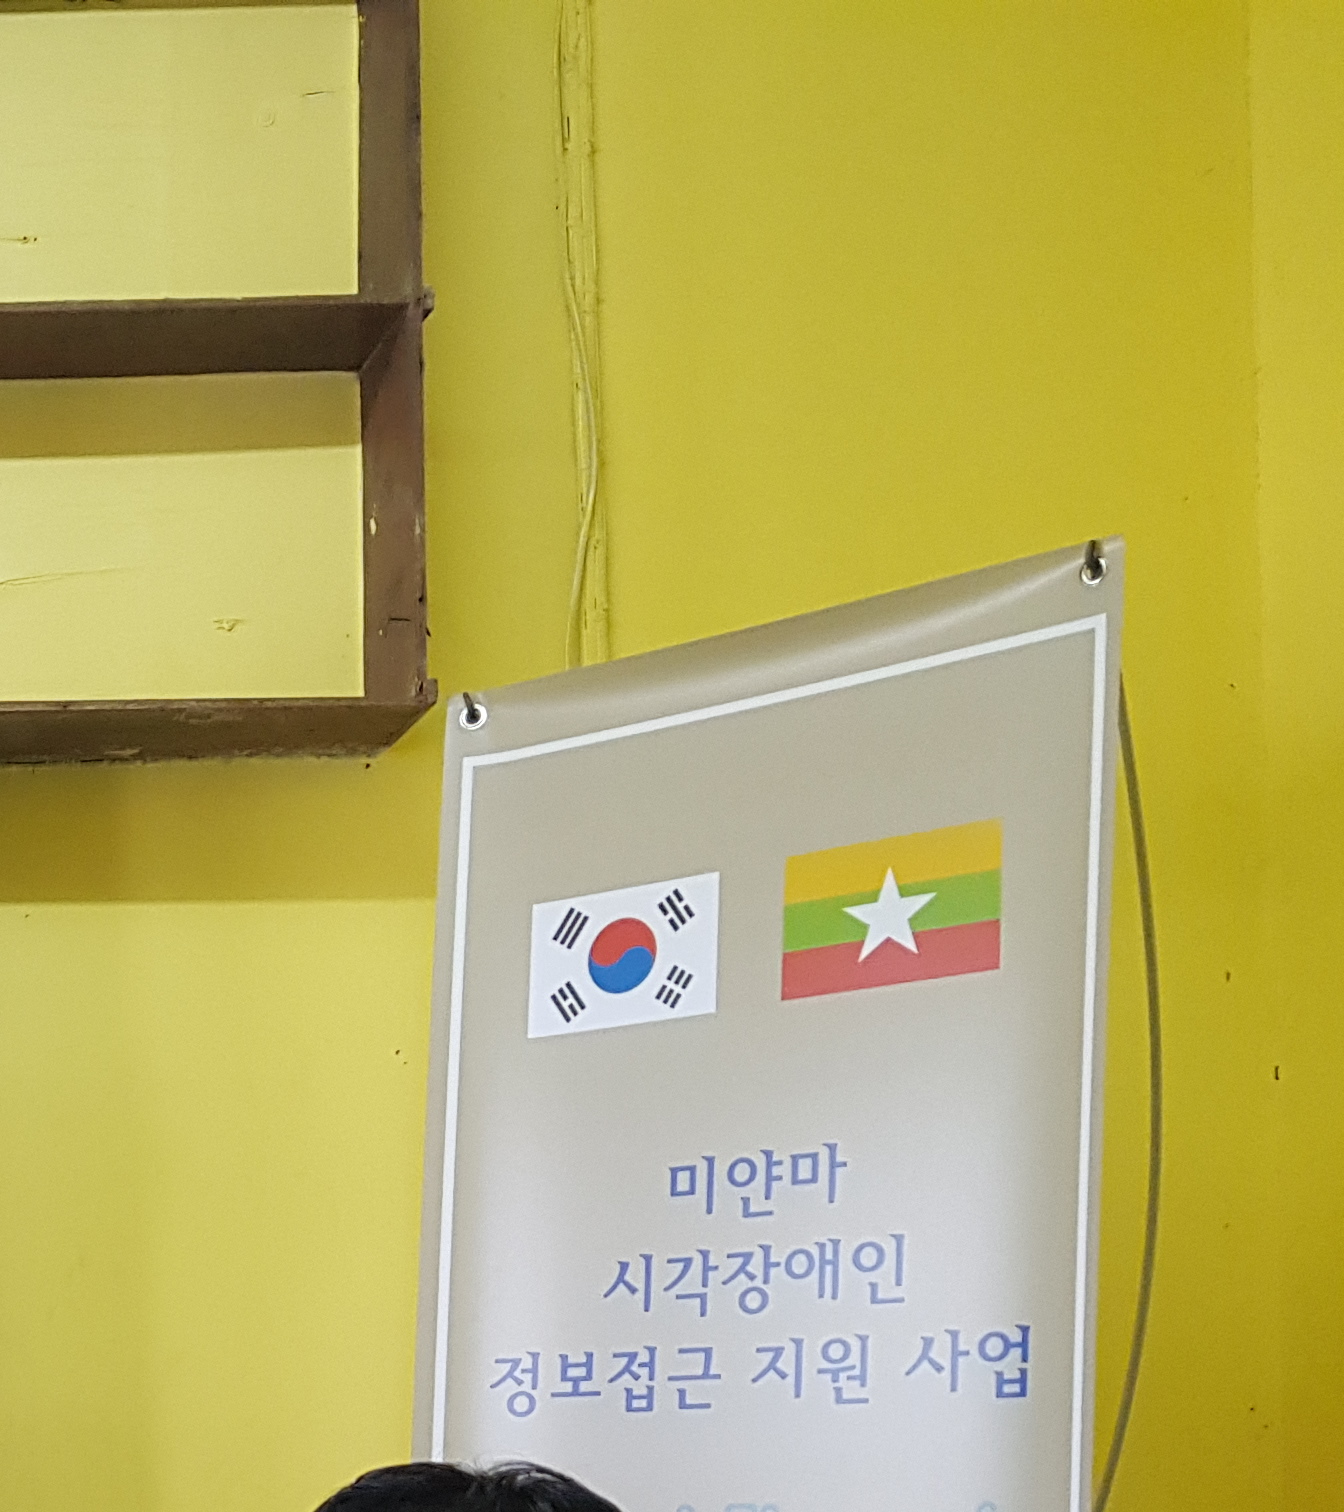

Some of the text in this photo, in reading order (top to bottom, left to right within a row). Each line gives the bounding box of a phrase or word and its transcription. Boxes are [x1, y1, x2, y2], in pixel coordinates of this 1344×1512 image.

[668, 1142, 848, 1218] 미얀마
[602, 1233, 908, 1317] 시각장애인
[489, 1324, 1032, 1418] 정보접근 지원 사업
